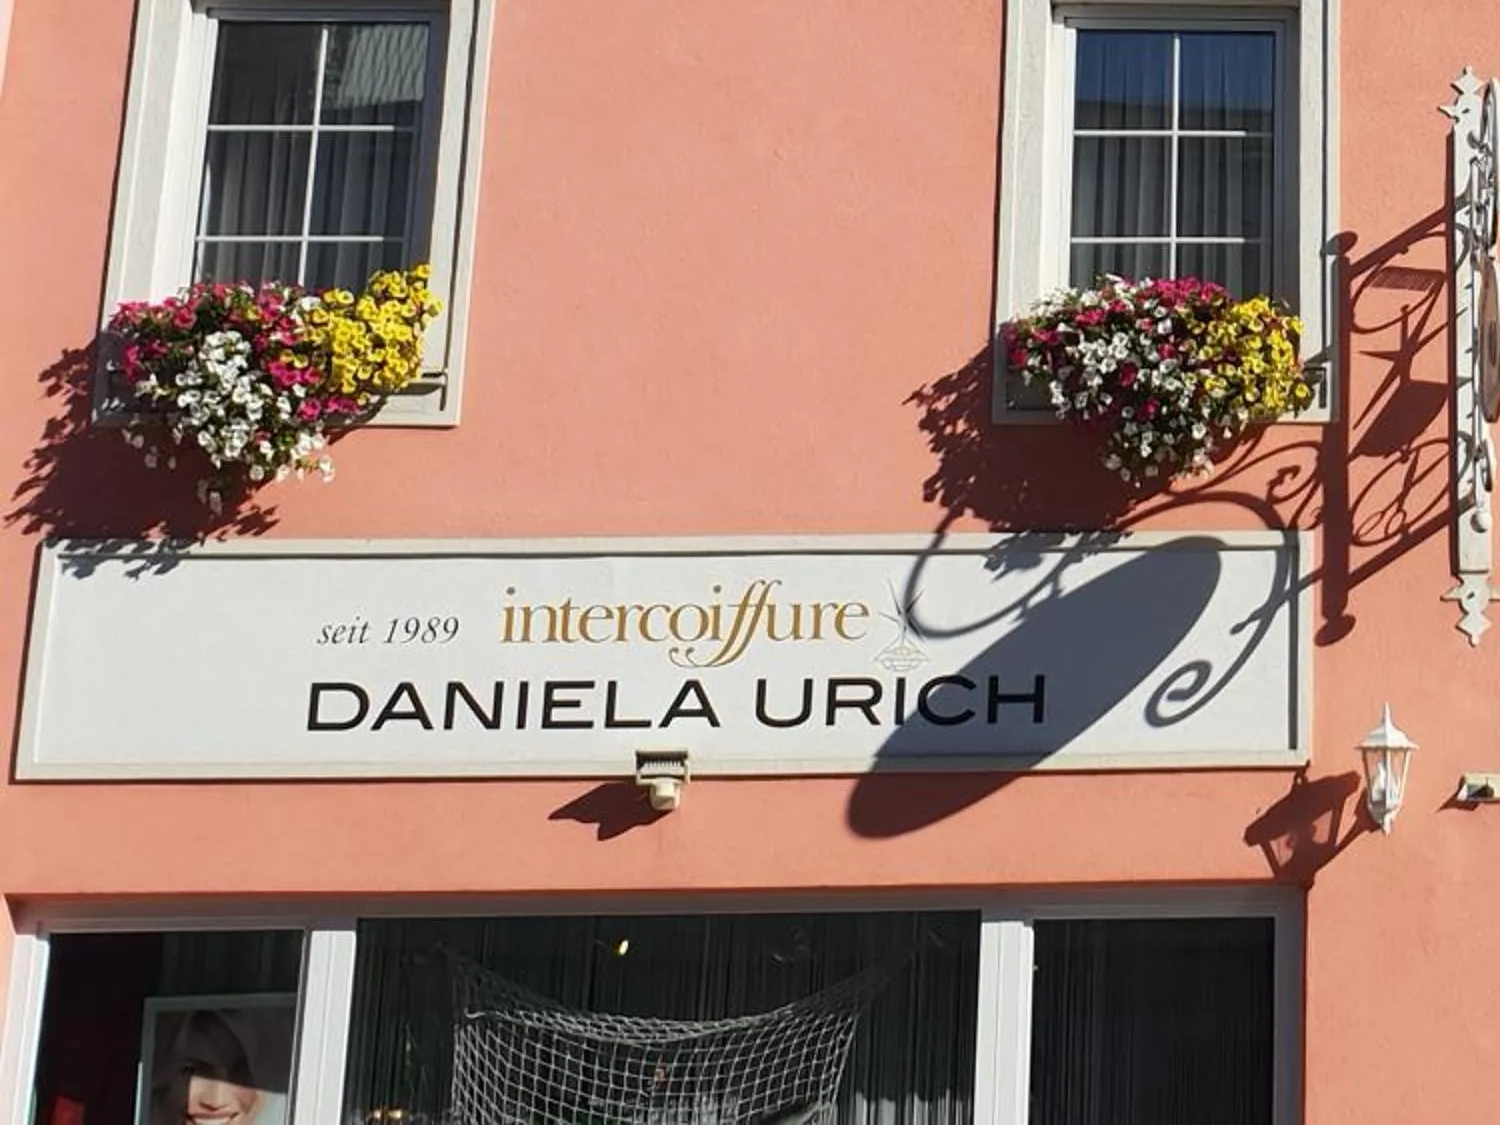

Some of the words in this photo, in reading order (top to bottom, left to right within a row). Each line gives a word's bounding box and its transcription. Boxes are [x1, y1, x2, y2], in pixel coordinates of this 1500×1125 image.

[317, 616, 370, 645] seit
[383, 616, 461, 644] 1989
[500, 579, 871, 668] intercoiffure
[307, 678, 721, 731] DANIELA
[755, 675, 1046, 728] URICH
